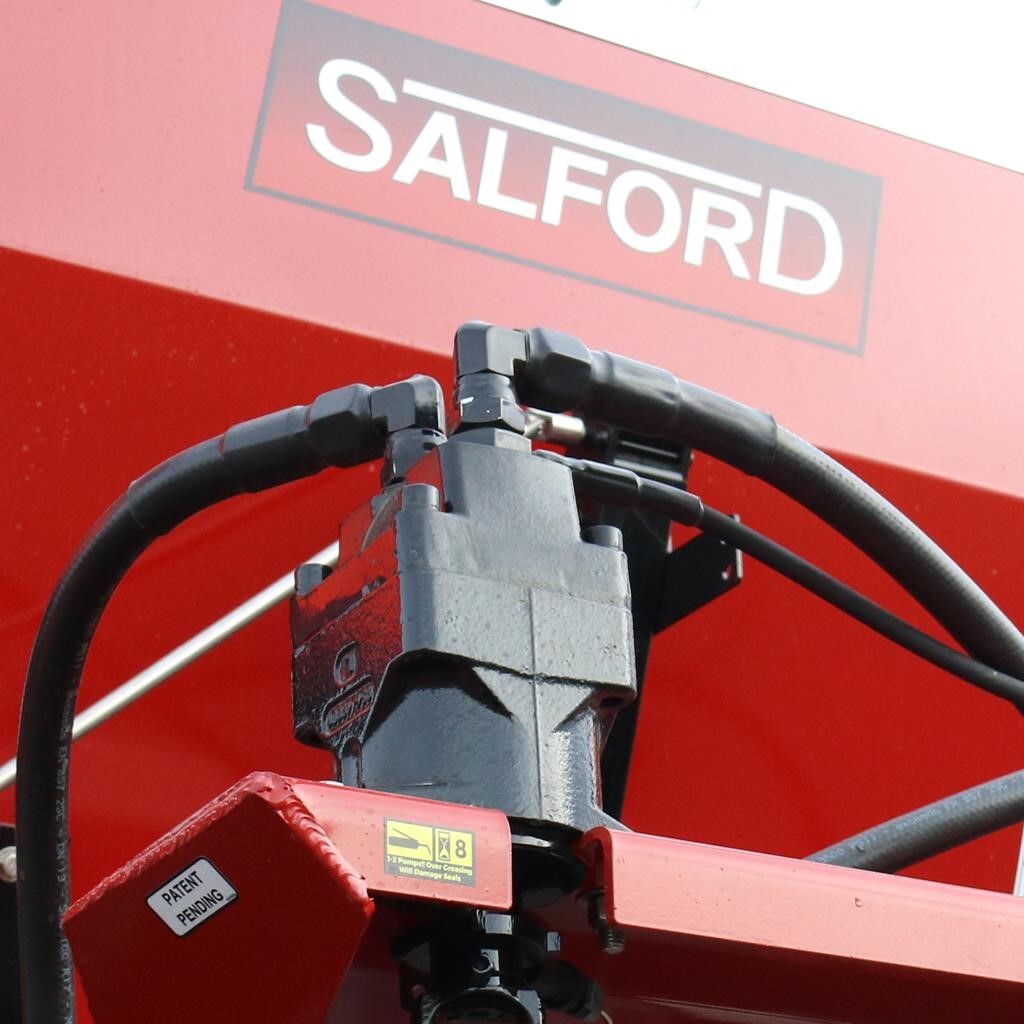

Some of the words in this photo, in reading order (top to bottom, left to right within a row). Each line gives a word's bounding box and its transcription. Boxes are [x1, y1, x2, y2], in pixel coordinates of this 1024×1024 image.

[305, 58, 845, 297] SALFORD
[455, 839, 467, 859] 8
[399, 866, 414, 875] Will
[414, 867, 442, 880] Damage
[443, 872, 461, 882] Seals
[426, 861, 442, 869] Over
[161, 870, 203, 906] PATENT
[176, 888, 224, 927] PENDING
